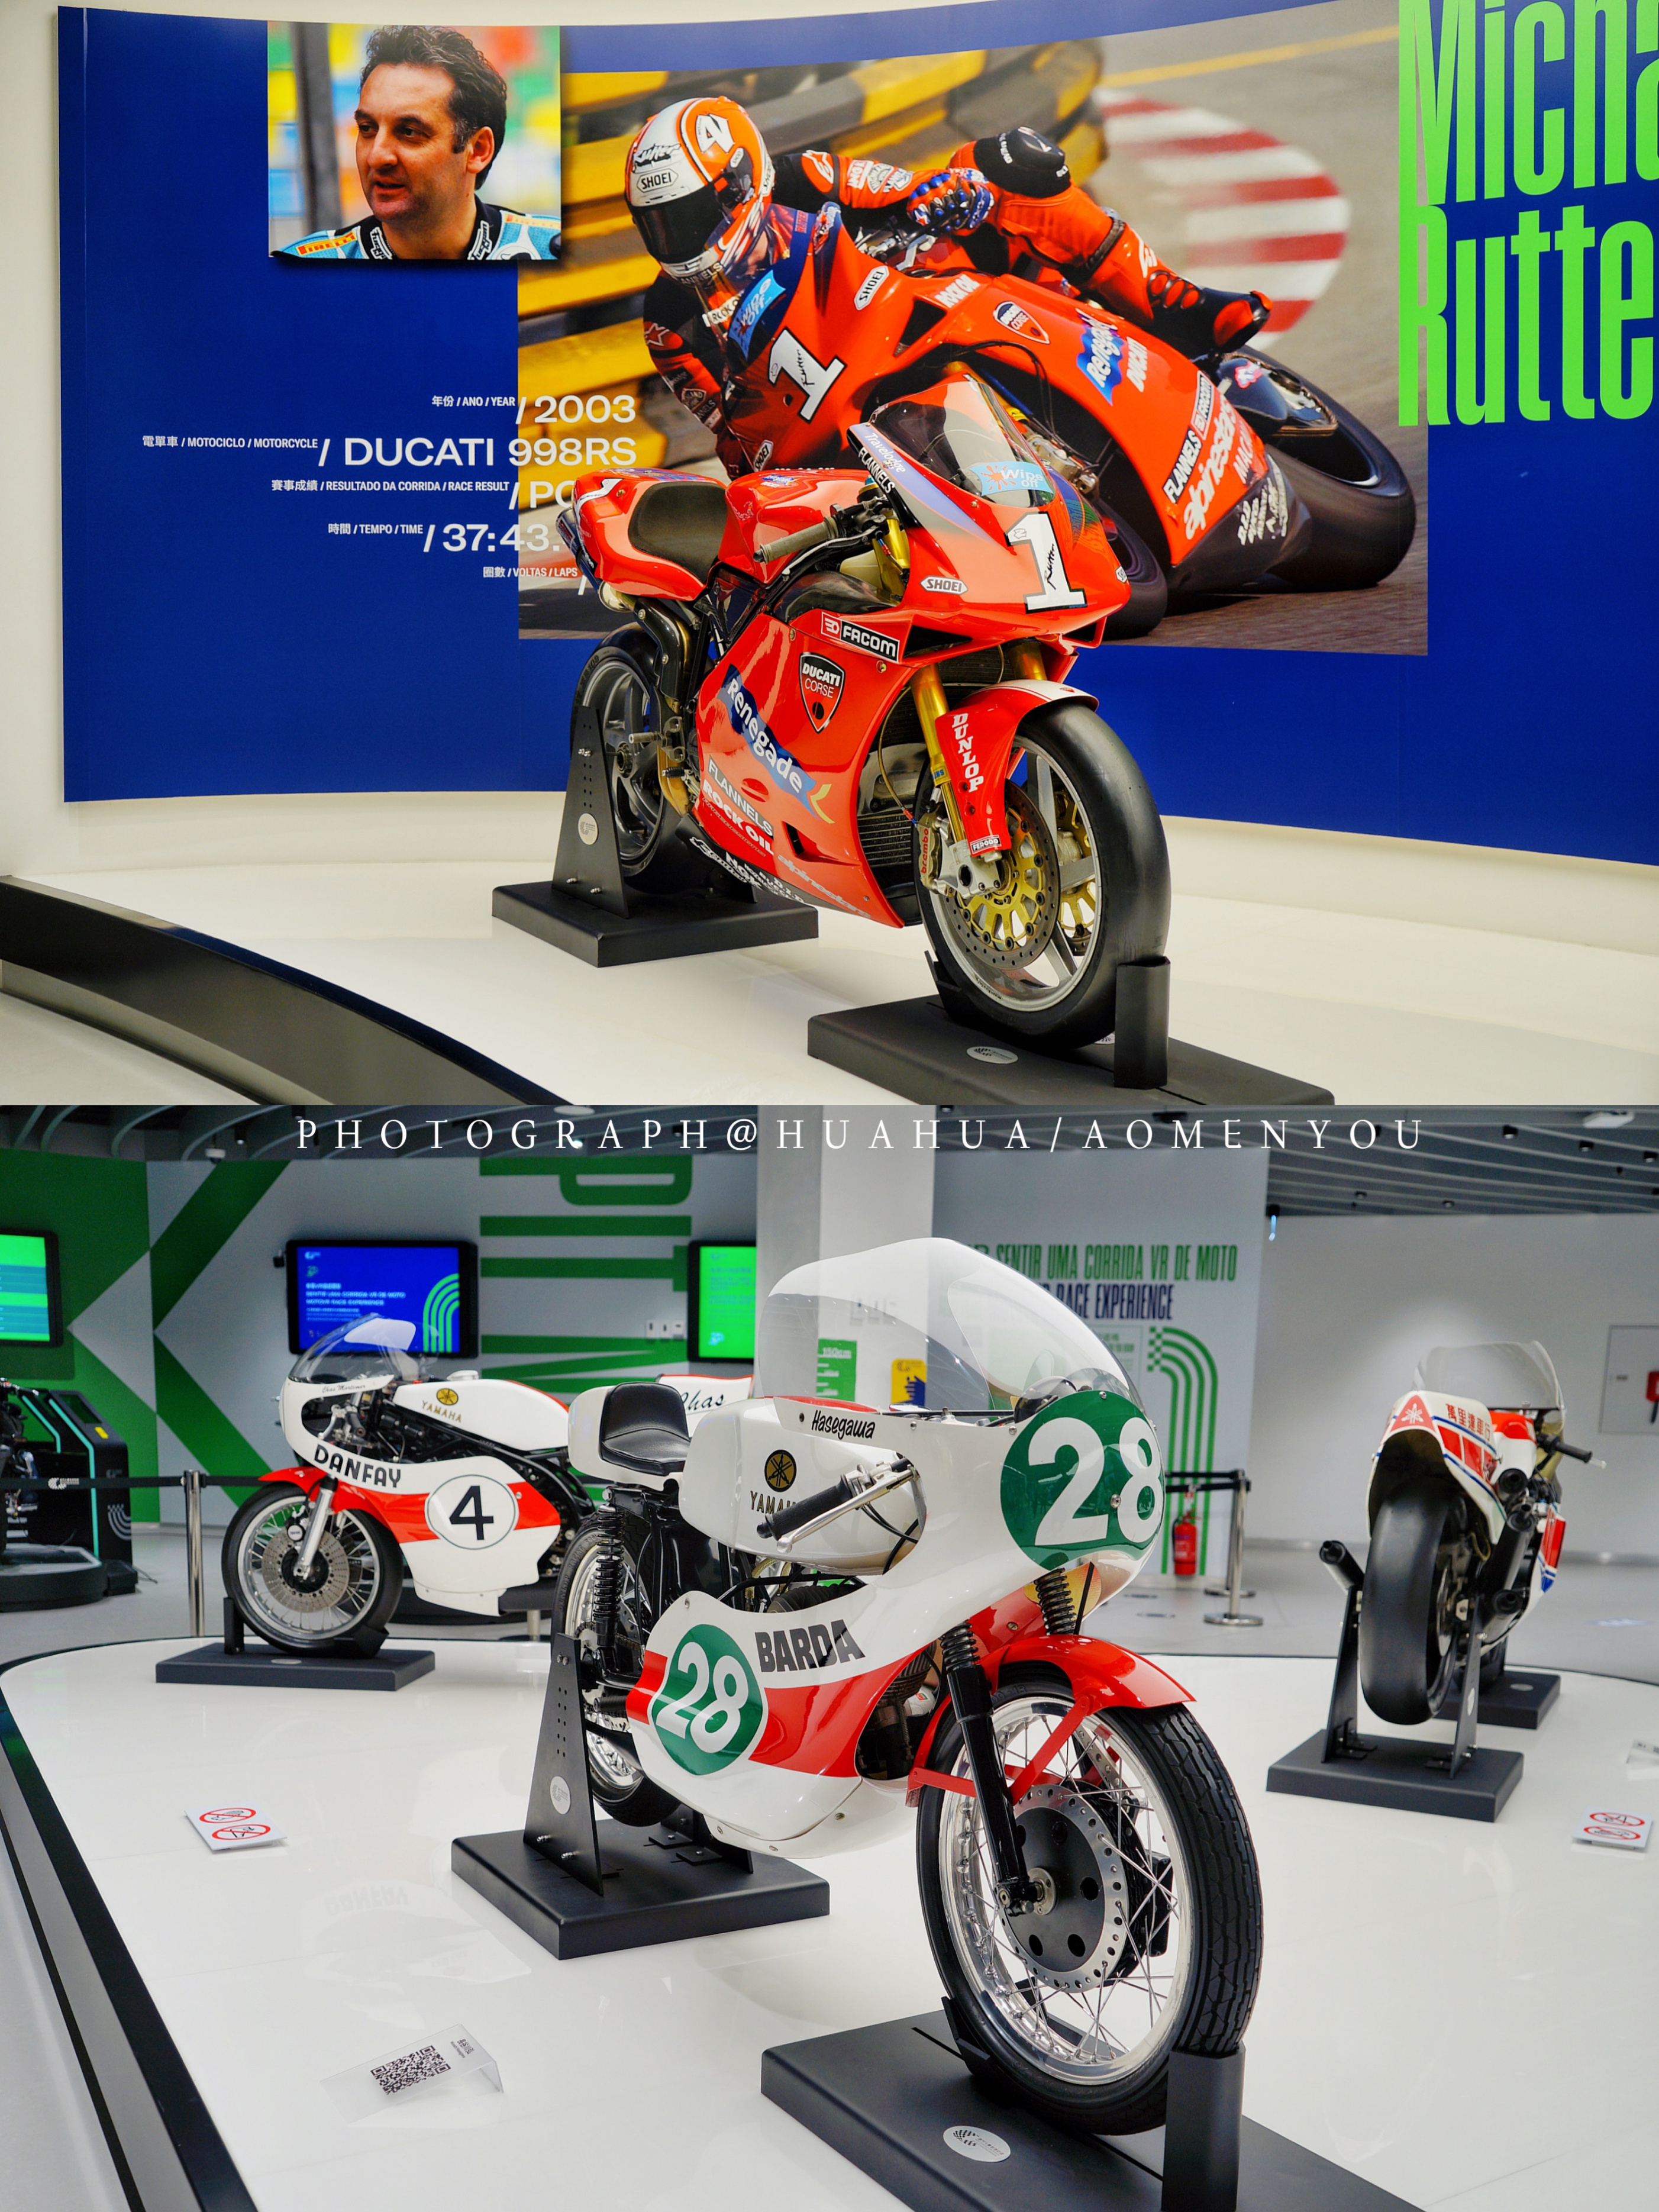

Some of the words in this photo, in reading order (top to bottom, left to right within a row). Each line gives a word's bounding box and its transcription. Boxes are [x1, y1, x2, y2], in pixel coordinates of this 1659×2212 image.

[641, 172, 672, 189] SHOEI
[859, 272, 885, 301] SHOEI
[768, 326, 848, 424] 1
[432, 395, 454, 407] 年份
[462, 397, 483, 406] ANO
[491, 397, 515, 406] YEAR
[534, 395, 636, 423] 2003
[143, 436, 178, 447] 電單車
[188, 437, 245, 447] MOTOCICLO
[254, 438, 318, 448] MOTORCYCLE
[345, 437, 493, 466] DUCATI
[508, 437, 637, 466] 998RS
[864, 433, 906, 472] Travelodge
[1163, 430, 1202, 503] FLANNELS
[272, 480, 318, 491] 賽事成績
[326, 481, 380, 491] RESULTADO
[383, 482, 396, 491] DA
[398, 482, 441, 491] CORRIDA
[448, 482, 473, 491] RACE
[475, 482, 509, 491] RESULT
[858, 447, 895, 493] FLANNELS
[1000, 469, 1043, 482] Wipe
[1021, 479, 1038, 488] Off
[328, 523, 351, 534] 時間
[359, 524, 392, 534] TEMPO
[400, 525, 423, 534] TIME
[483, 566, 505, 578] 圈數
[513, 567, 547, 578] VOLTAS
[554, 567, 577, 577] LAPS
[1004, 511, 1087, 614] 1
[927, 578, 963, 592] SHOEI
[843, 625, 896, 657] FACOM
[802, 663, 841, 687] DUCATI
[805, 678, 835, 698] CORSE
[727, 678, 803, 794] Renegade
[952, 713, 984, 793] DUNLOP
[708, 759, 773, 836] FLANNELS
[703, 779, 744, 831] ROCK
[745, 825, 774, 856] OIL
[920, 828, 928, 873] brembo
[972, 838, 999, 851] FERODO
[726, 851, 763, 890] NGK
[777, 855, 872, 919] alpinestars
[1047, 1244, 1079, 1279] UMA
[1085, 1244, 1144, 1281] CORRIDA
[1150, 1244, 1169, 1280] VR
[1174, 1244, 1192, 1281] DE
[1195, 1244, 1238, 1281] MOTO
[1095, 1283, 1175, 1320] EXPERIENCE
[421, 1400, 463, 1423] YAMAHA
[811, 1409, 876, 1440] Hasegawa
[314, 1444, 402, 1488] DANFAY
[1028, 1417, 1164, 1547] 28
[449, 1485, 495, 1541] 4
[755, 1619, 866, 1672] BARDA
[656, 1642, 749, 1753] 28
